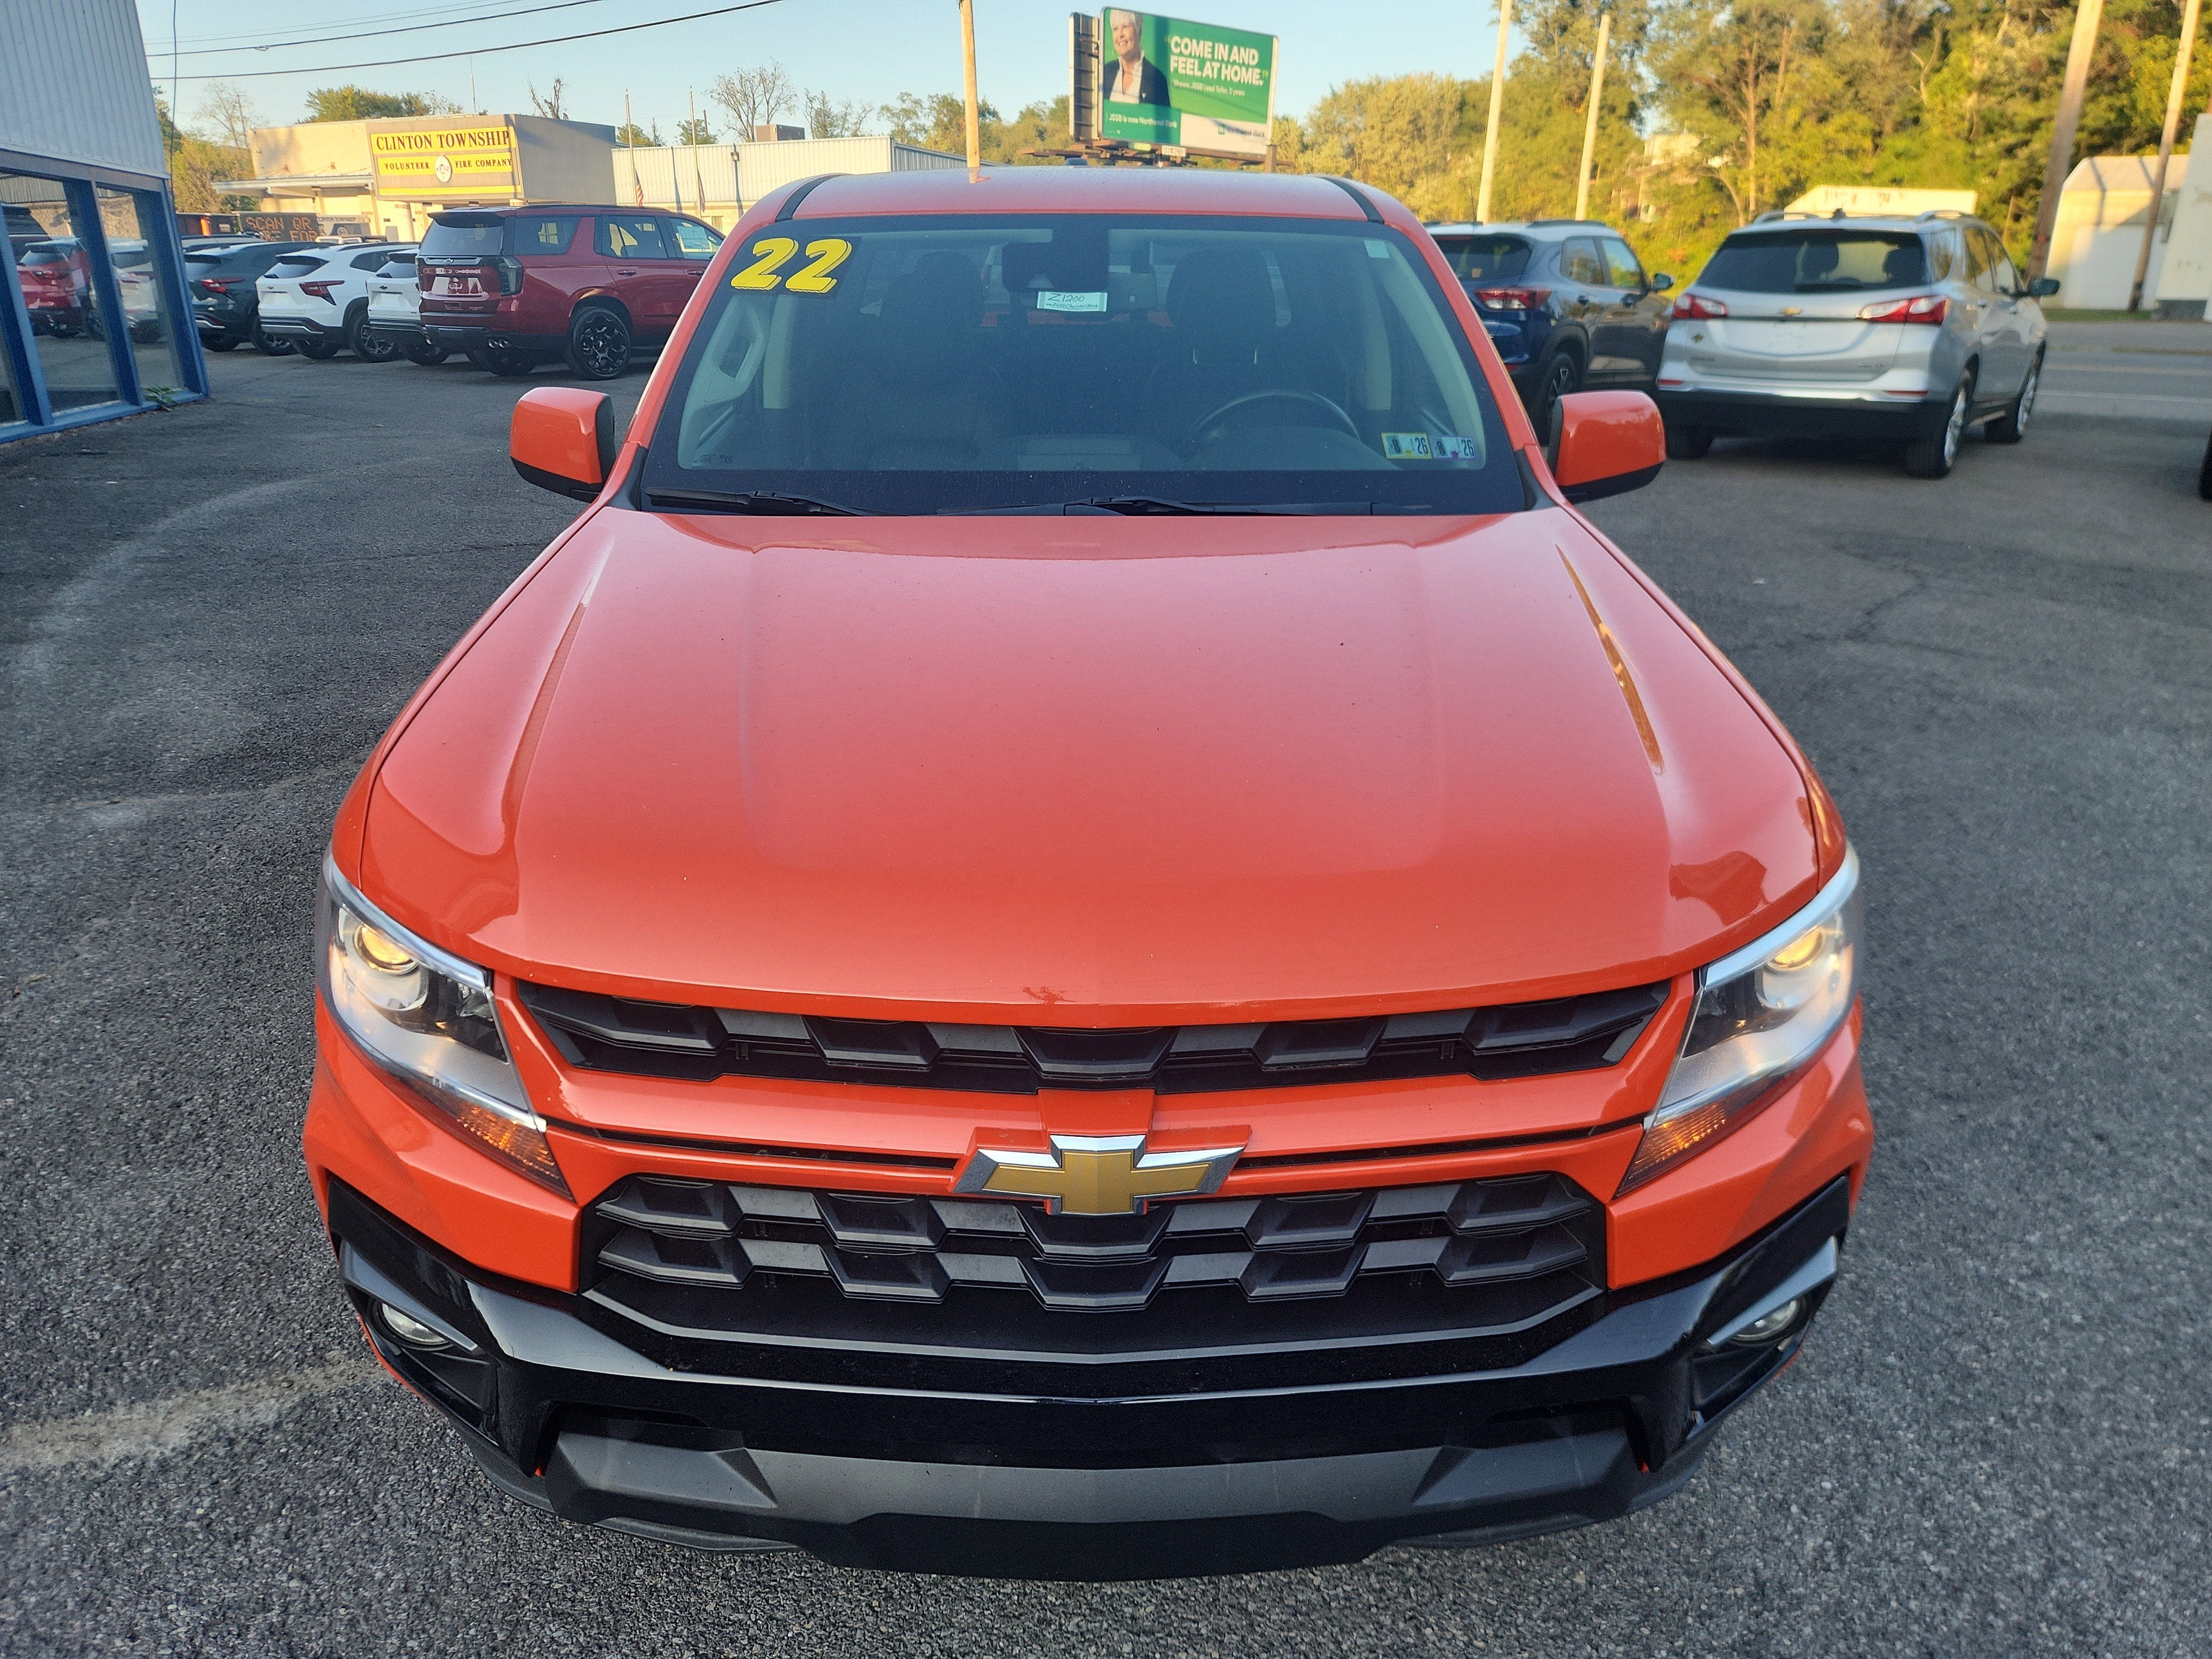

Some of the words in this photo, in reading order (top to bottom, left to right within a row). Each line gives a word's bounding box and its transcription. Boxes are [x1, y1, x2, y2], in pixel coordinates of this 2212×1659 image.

[1214, 42, 1230, 61] IN
[1230, 45, 1259, 66] AND
[1171, 55, 1201, 77] FEEL
[1202, 61, 1220, 79] AT
[376, 134, 433, 151] CLINTON
[436, 130, 510, 149] TOWNSHIP
[384, 162, 430, 170] VOLUNTEER
[455, 160, 472, 168] FIRE
[475, 158, 513, 167] COMPANY
[246, 217, 285, 231] SCAN
[293, 217, 313, 231] QR
[290, 230, 318, 242] FOR
[731, 237, 852, 293] 22
[1415, 437, 1429, 455] 26
[1461, 439, 1475, 456] 26
